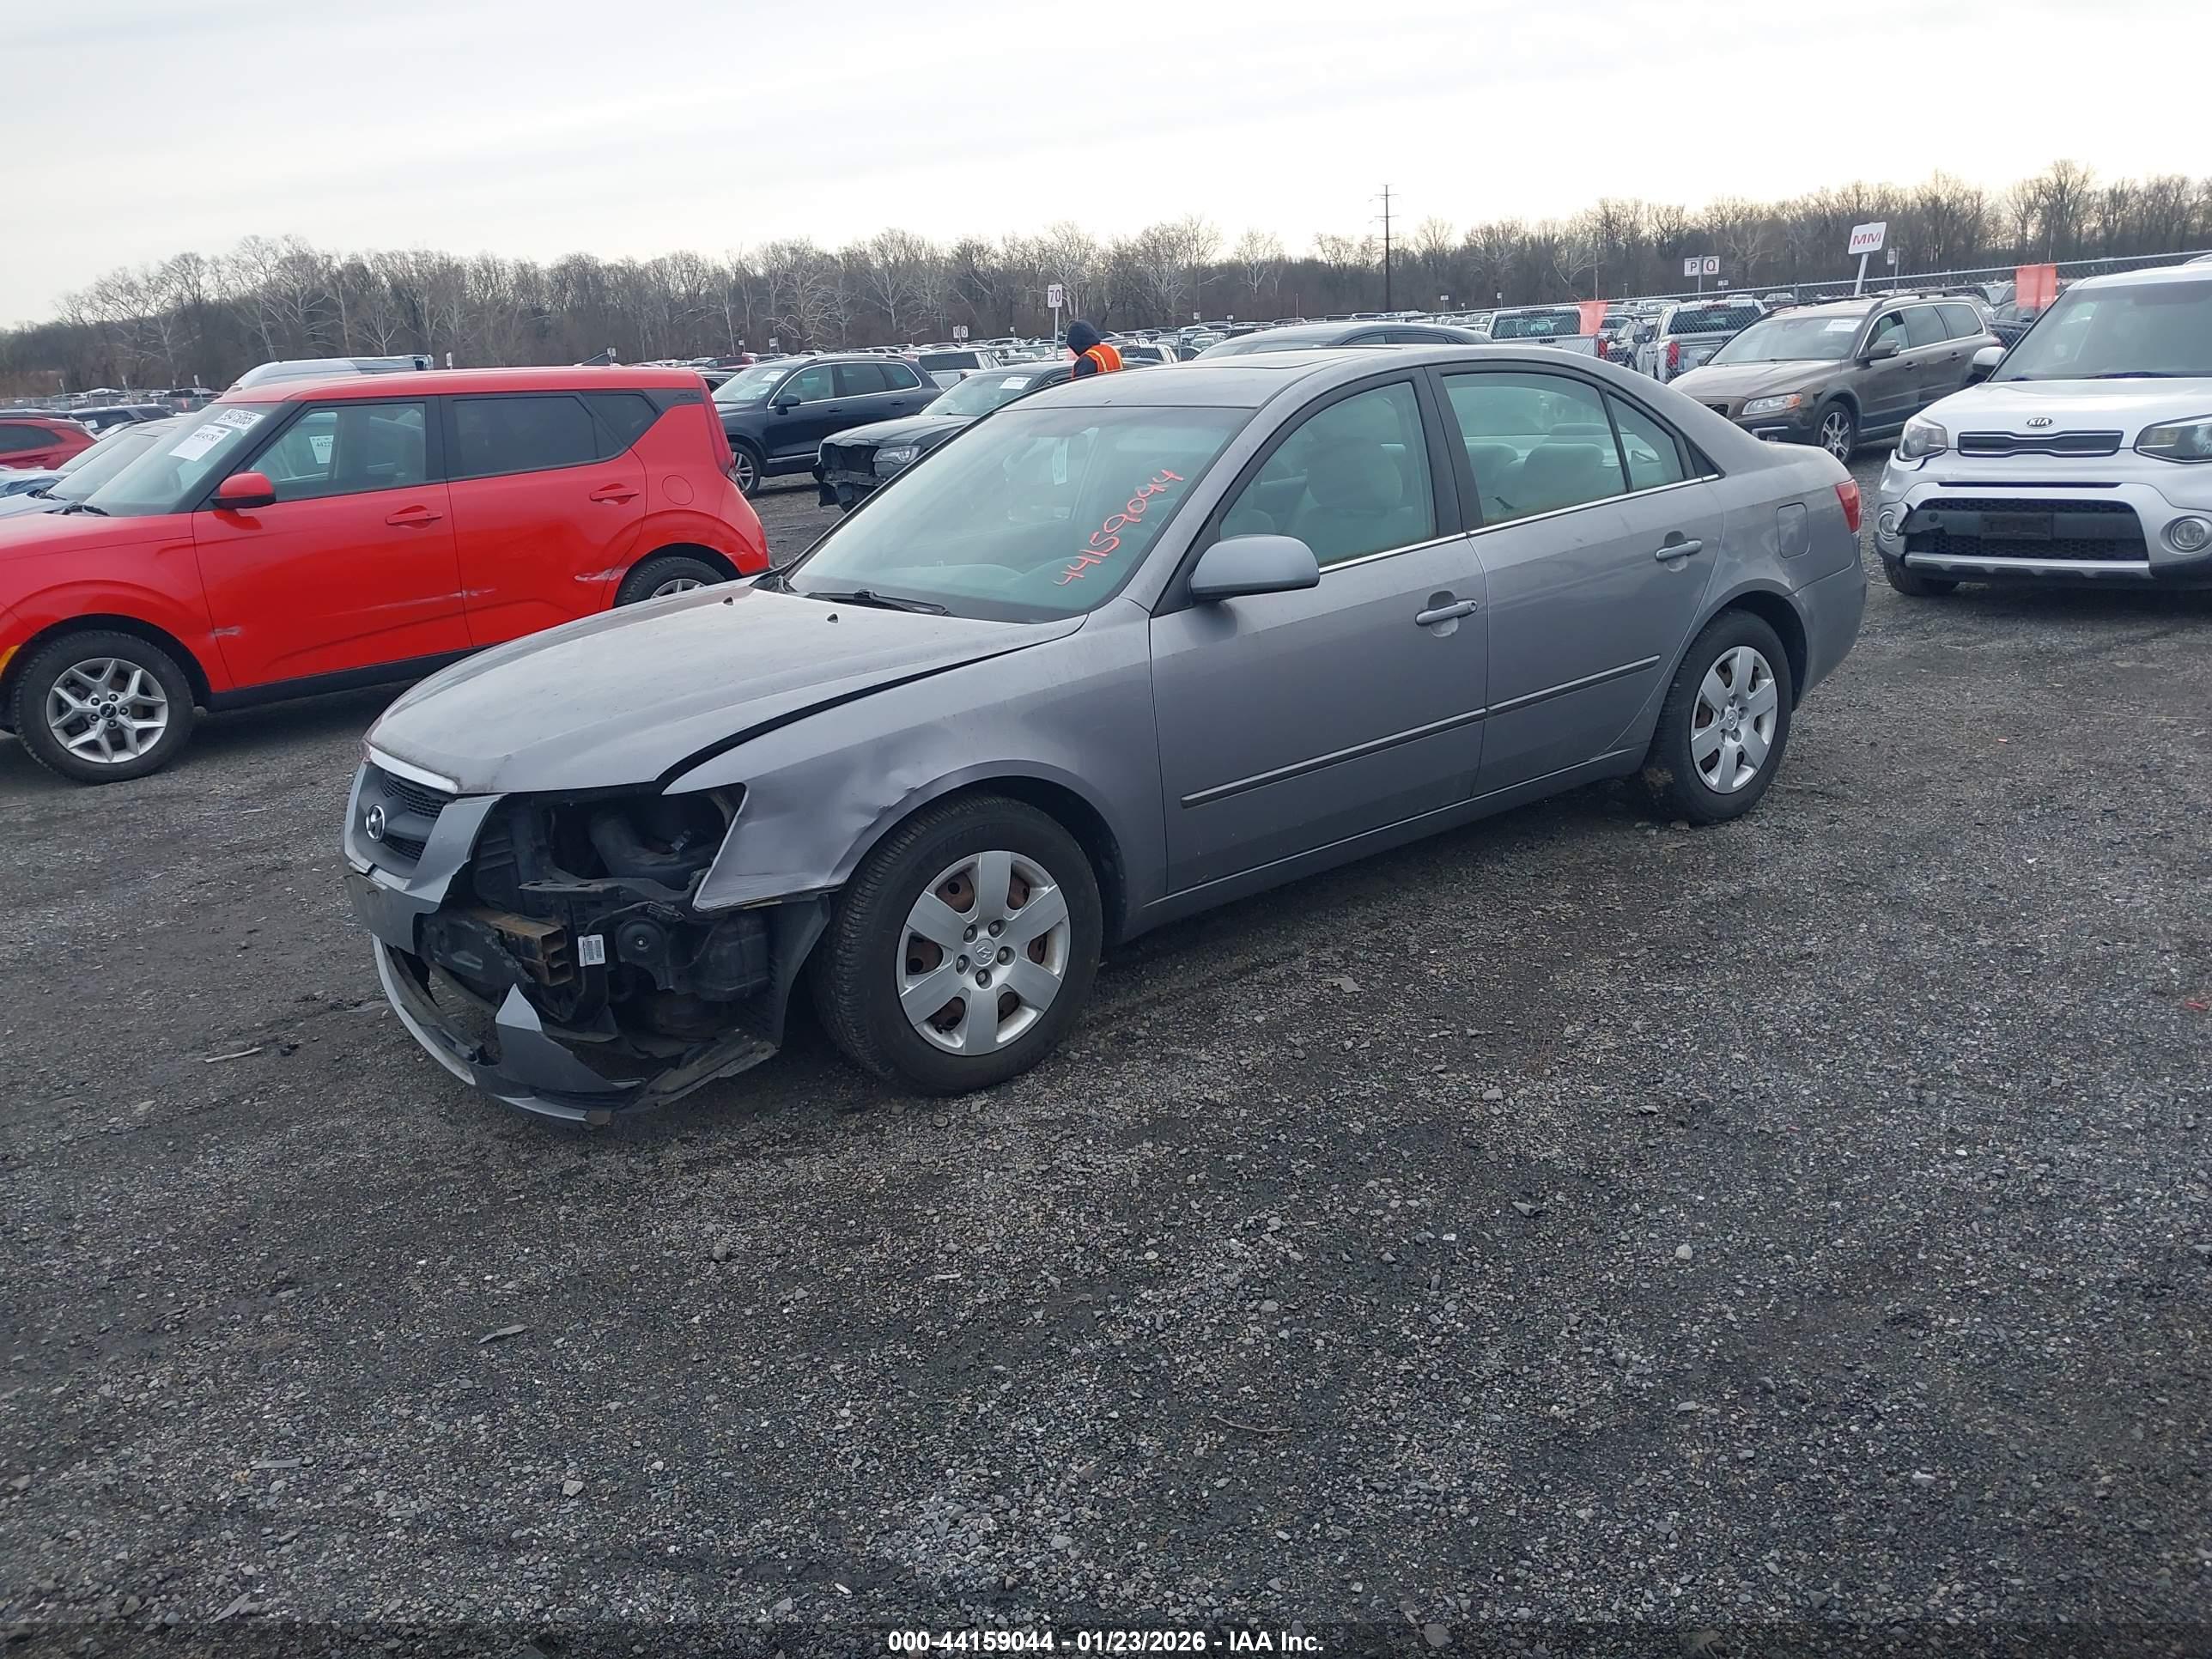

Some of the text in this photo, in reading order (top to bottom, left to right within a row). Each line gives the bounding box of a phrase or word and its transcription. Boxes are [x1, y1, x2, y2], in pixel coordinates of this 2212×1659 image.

[1852, 232, 1881, 246] MM
[1690, 261, 1698, 272] P
[1706, 259, 1717, 271] Q
[1048, 289, 1061, 302] 70
[1051, 469, 1185, 586] 44159044
